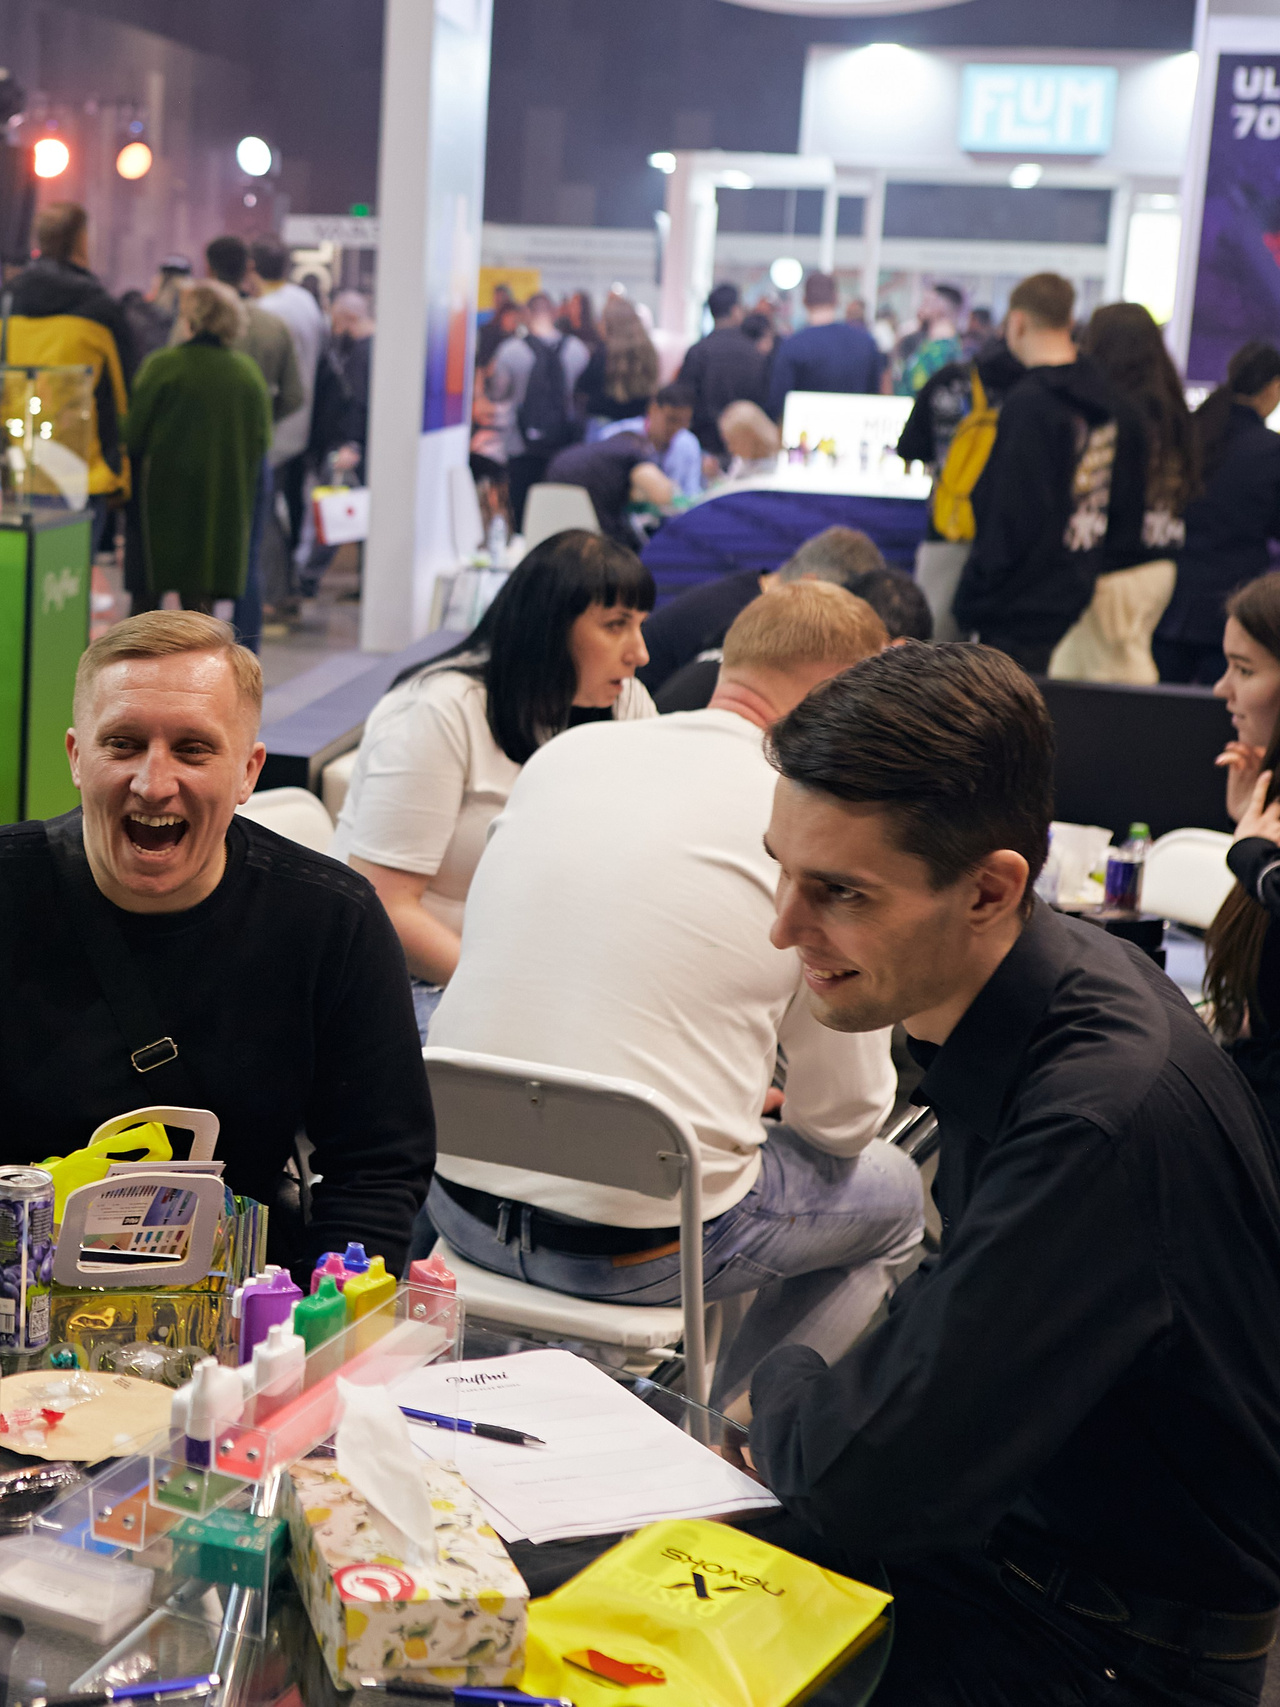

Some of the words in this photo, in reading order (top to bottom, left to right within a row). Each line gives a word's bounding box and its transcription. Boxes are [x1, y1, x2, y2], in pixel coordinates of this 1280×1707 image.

[971, 75, 1105, 145] FLUM
[445, 1371, 510, 1388] Puffmi
[661, 1547, 786, 1597] nevoks
